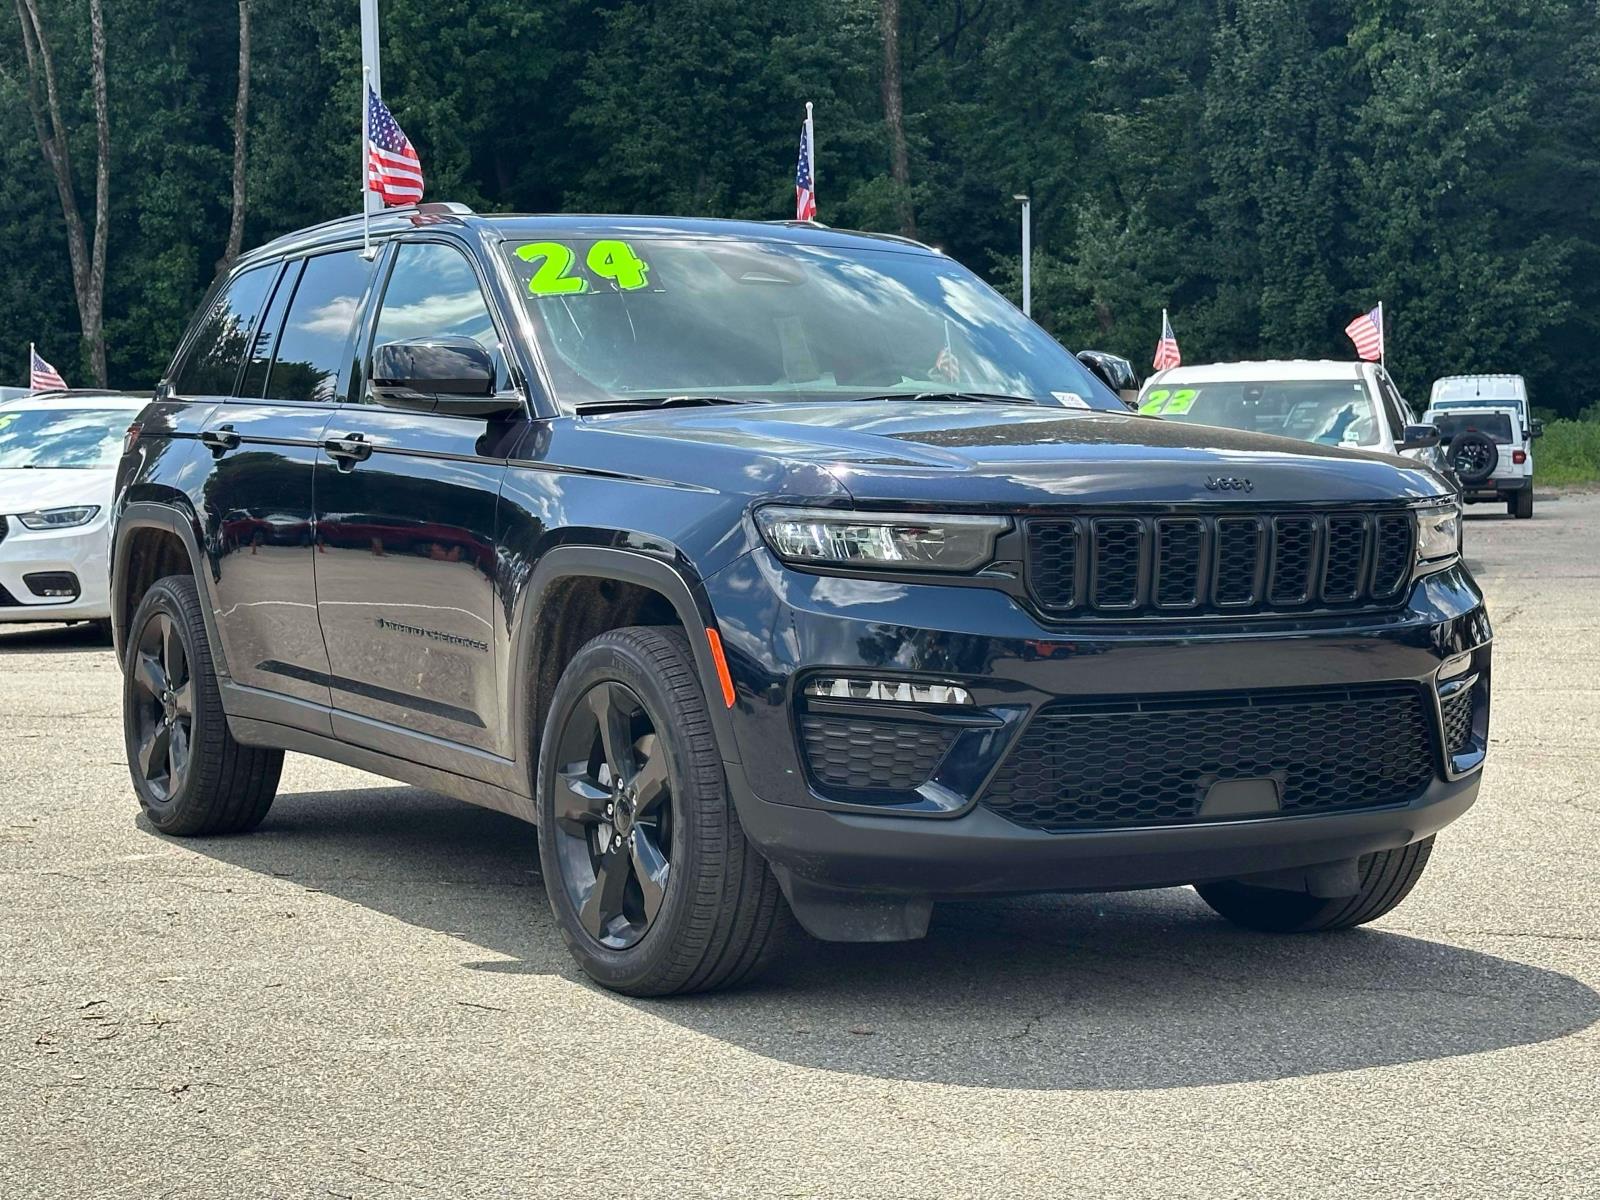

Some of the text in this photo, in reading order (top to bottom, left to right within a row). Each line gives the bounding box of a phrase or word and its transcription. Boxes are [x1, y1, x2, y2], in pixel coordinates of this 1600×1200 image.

[514, 240, 649, 296] 24
[1138, 389, 1197, 415] 23
[1203, 475, 1254, 493] Jeep
